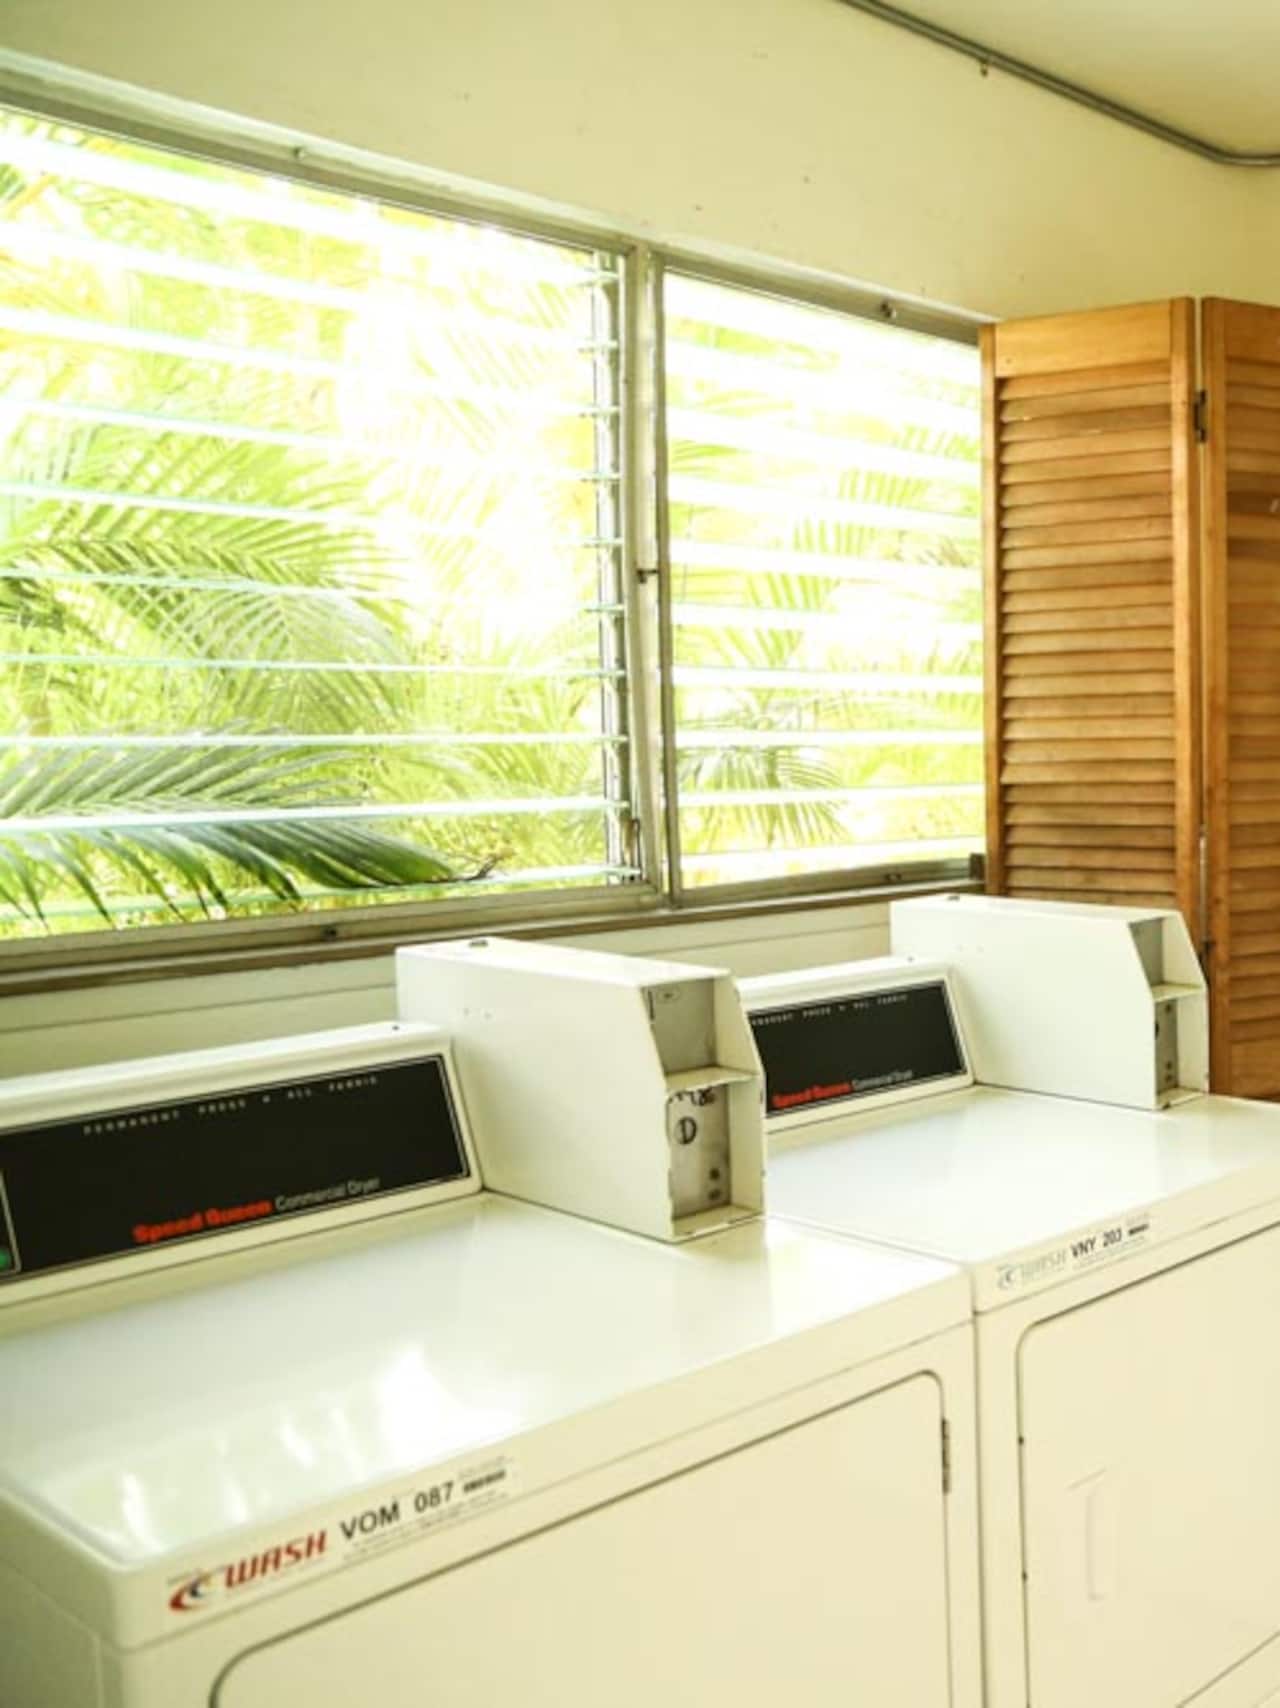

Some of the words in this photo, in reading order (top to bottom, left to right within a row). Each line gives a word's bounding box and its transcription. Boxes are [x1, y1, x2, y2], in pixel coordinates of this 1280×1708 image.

[133, 1213, 203, 1243] Speed
[205, 1199, 273, 1226] Queen
[275, 1184, 347, 1211] Commercial
[1070, 1236, 1096, 1258] VNY
[224, 1530, 328, 1590] WASH
[340, 1501, 402, 1541] VOM
[414, 1481, 454, 1513] 087
